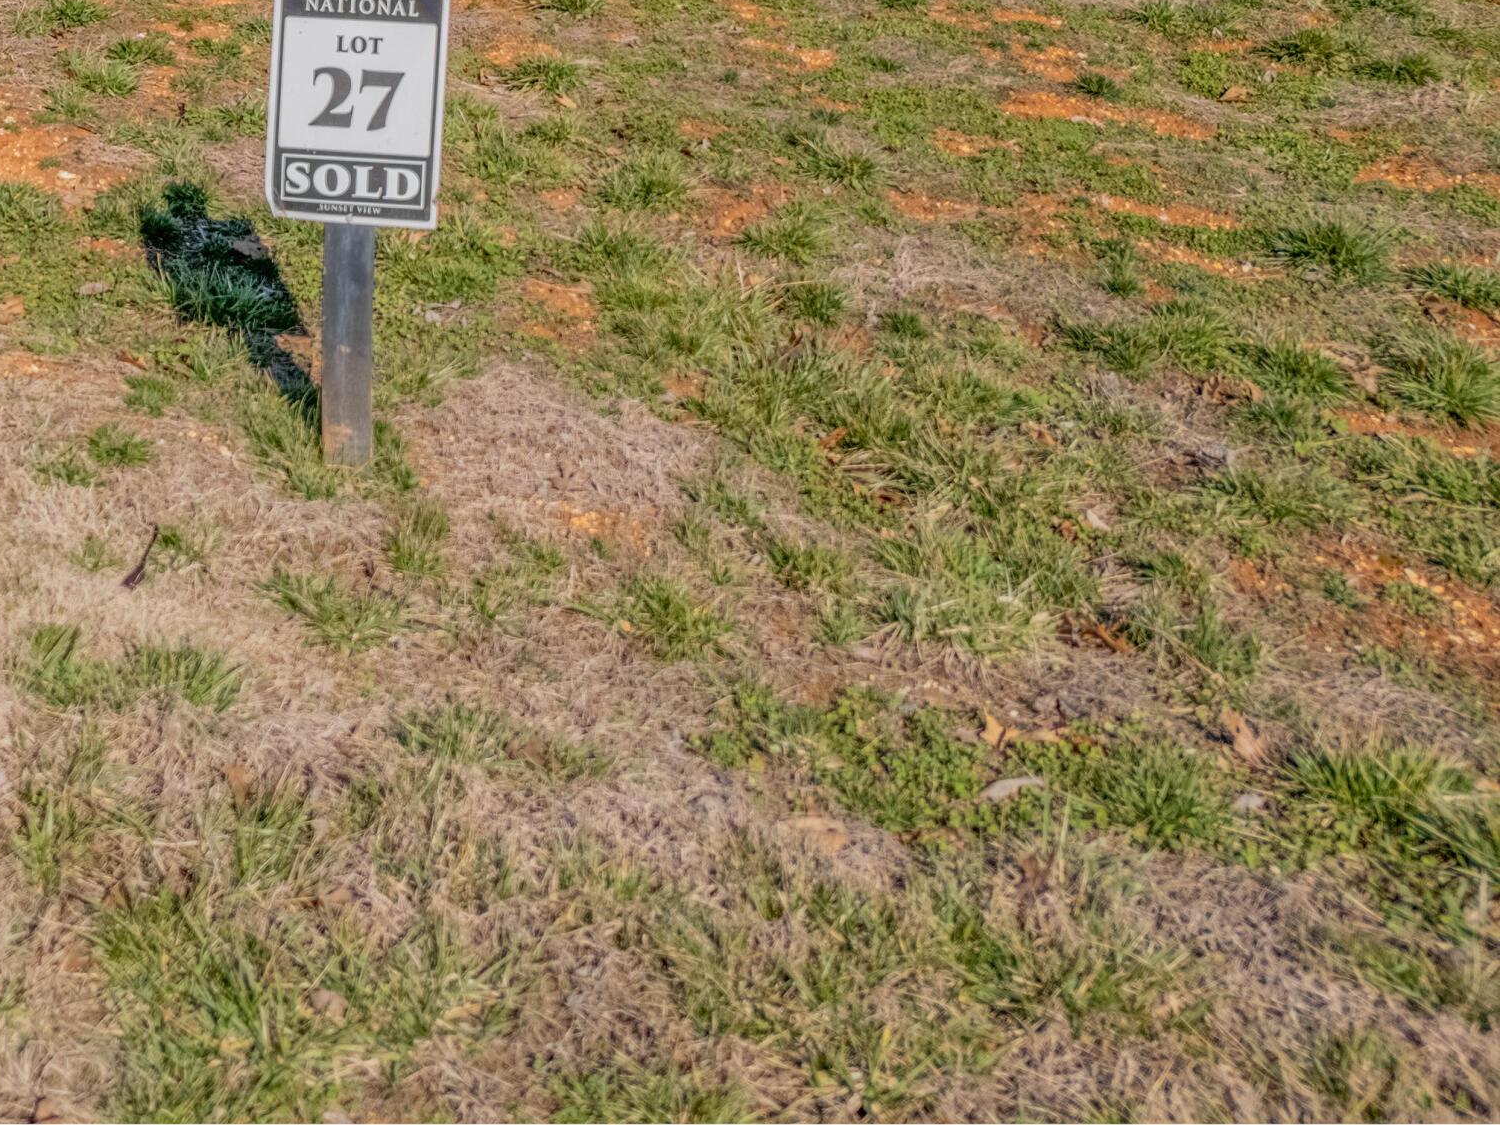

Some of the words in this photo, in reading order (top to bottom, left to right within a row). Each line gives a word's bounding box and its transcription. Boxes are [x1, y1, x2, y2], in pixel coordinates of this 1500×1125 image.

[336, 35, 383, 55] LOT
[308, 66, 405, 131] 27
[285, 162, 421, 201] SOLD
